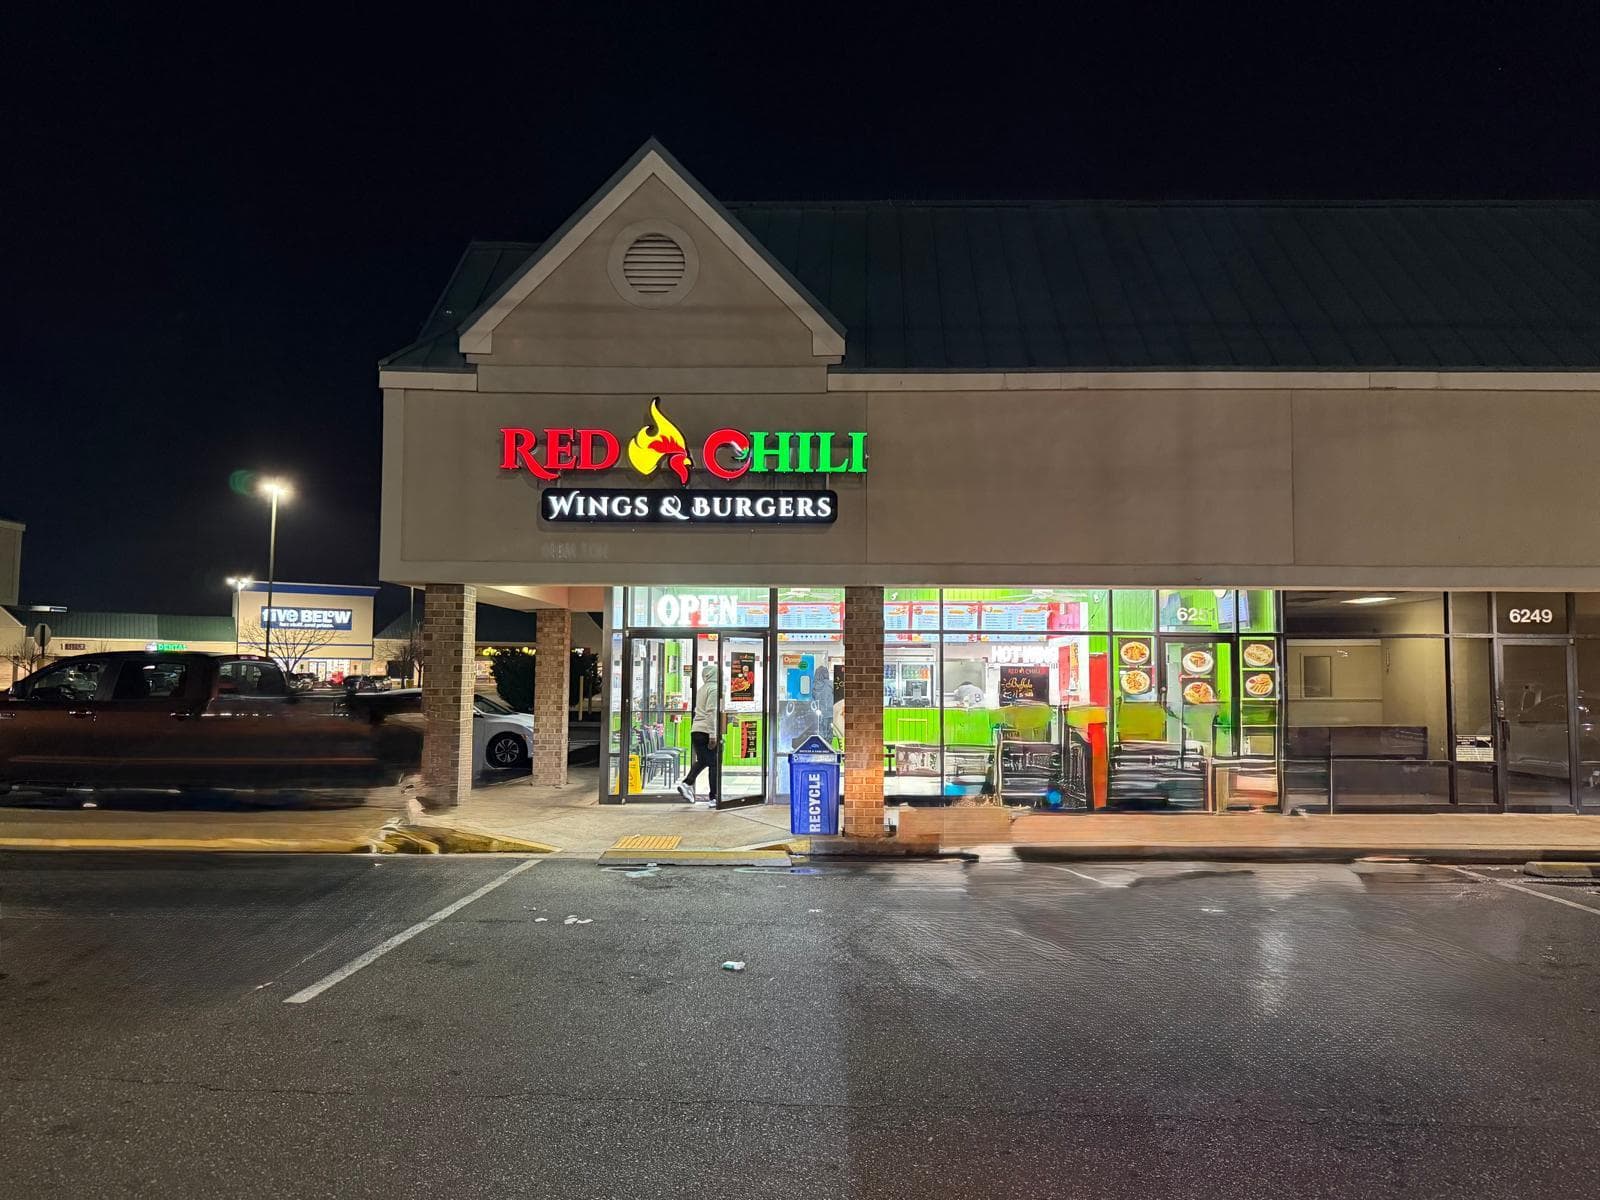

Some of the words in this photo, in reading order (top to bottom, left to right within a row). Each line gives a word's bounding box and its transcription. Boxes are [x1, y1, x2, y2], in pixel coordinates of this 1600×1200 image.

[500, 428, 620, 480] RED
[703, 428, 868, 479] CHILI
[548, 491, 649, 519] WINGS
[660, 495, 690, 520] &
[692, 497, 832, 517] BURGERS
[657, 594, 738, 625] OPEN
[1177, 607, 1216, 621] 6251
[1510, 608, 1553, 623] 6249
[808, 773, 821, 833] RECYCLE
